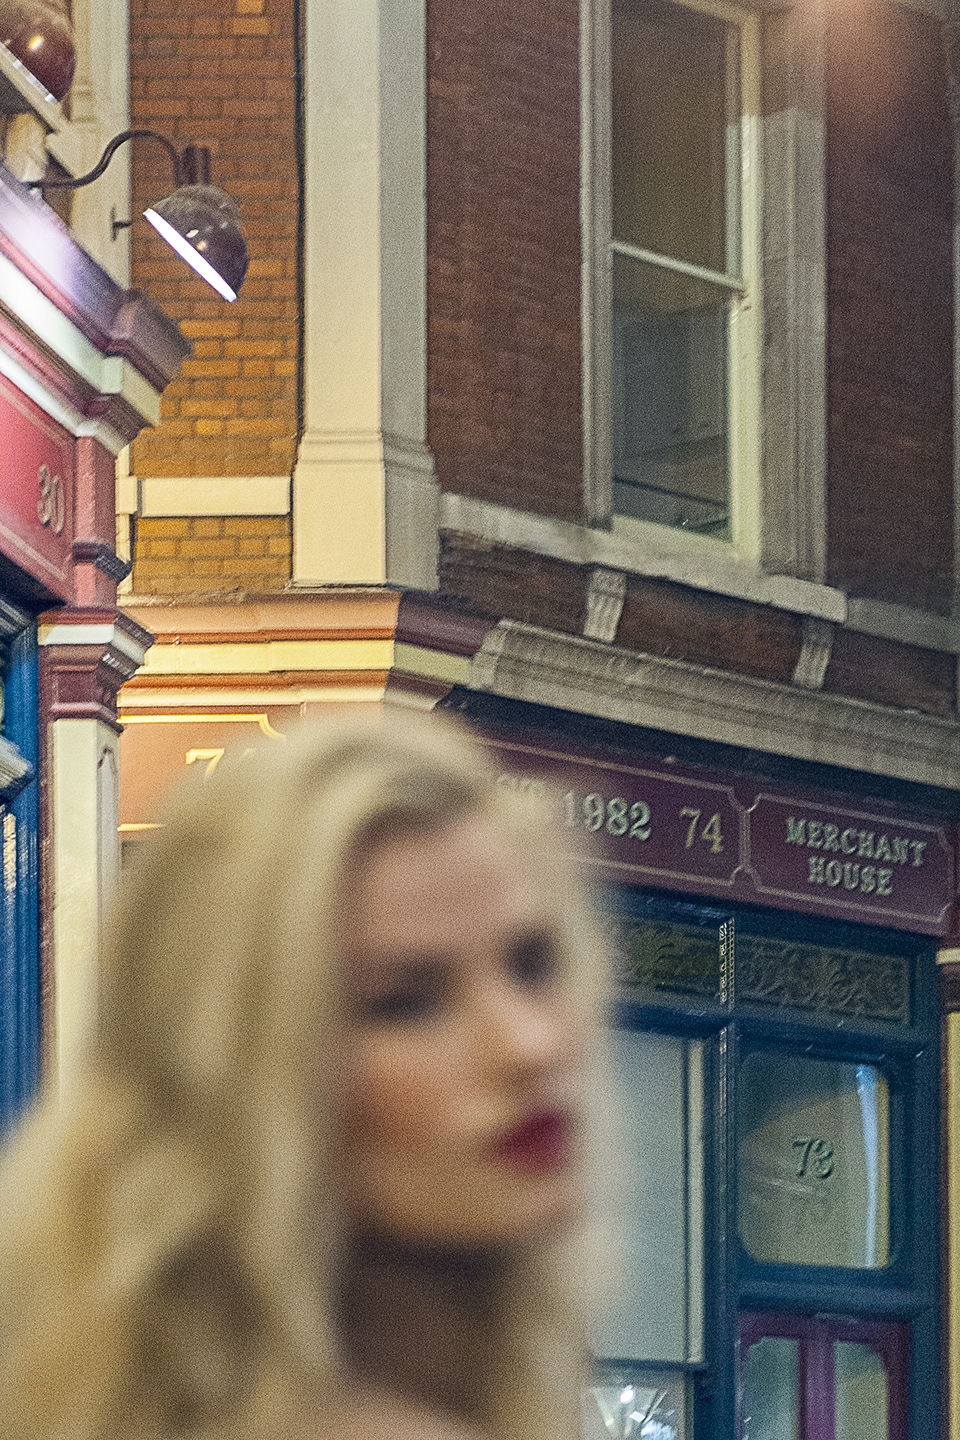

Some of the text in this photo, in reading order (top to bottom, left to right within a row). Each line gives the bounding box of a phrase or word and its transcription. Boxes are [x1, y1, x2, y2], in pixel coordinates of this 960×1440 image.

[565, 791, 723, 853] 1982 74
[785, 816, 927, 866] MERCHANT
[808, 856, 893, 896] HOUSE
